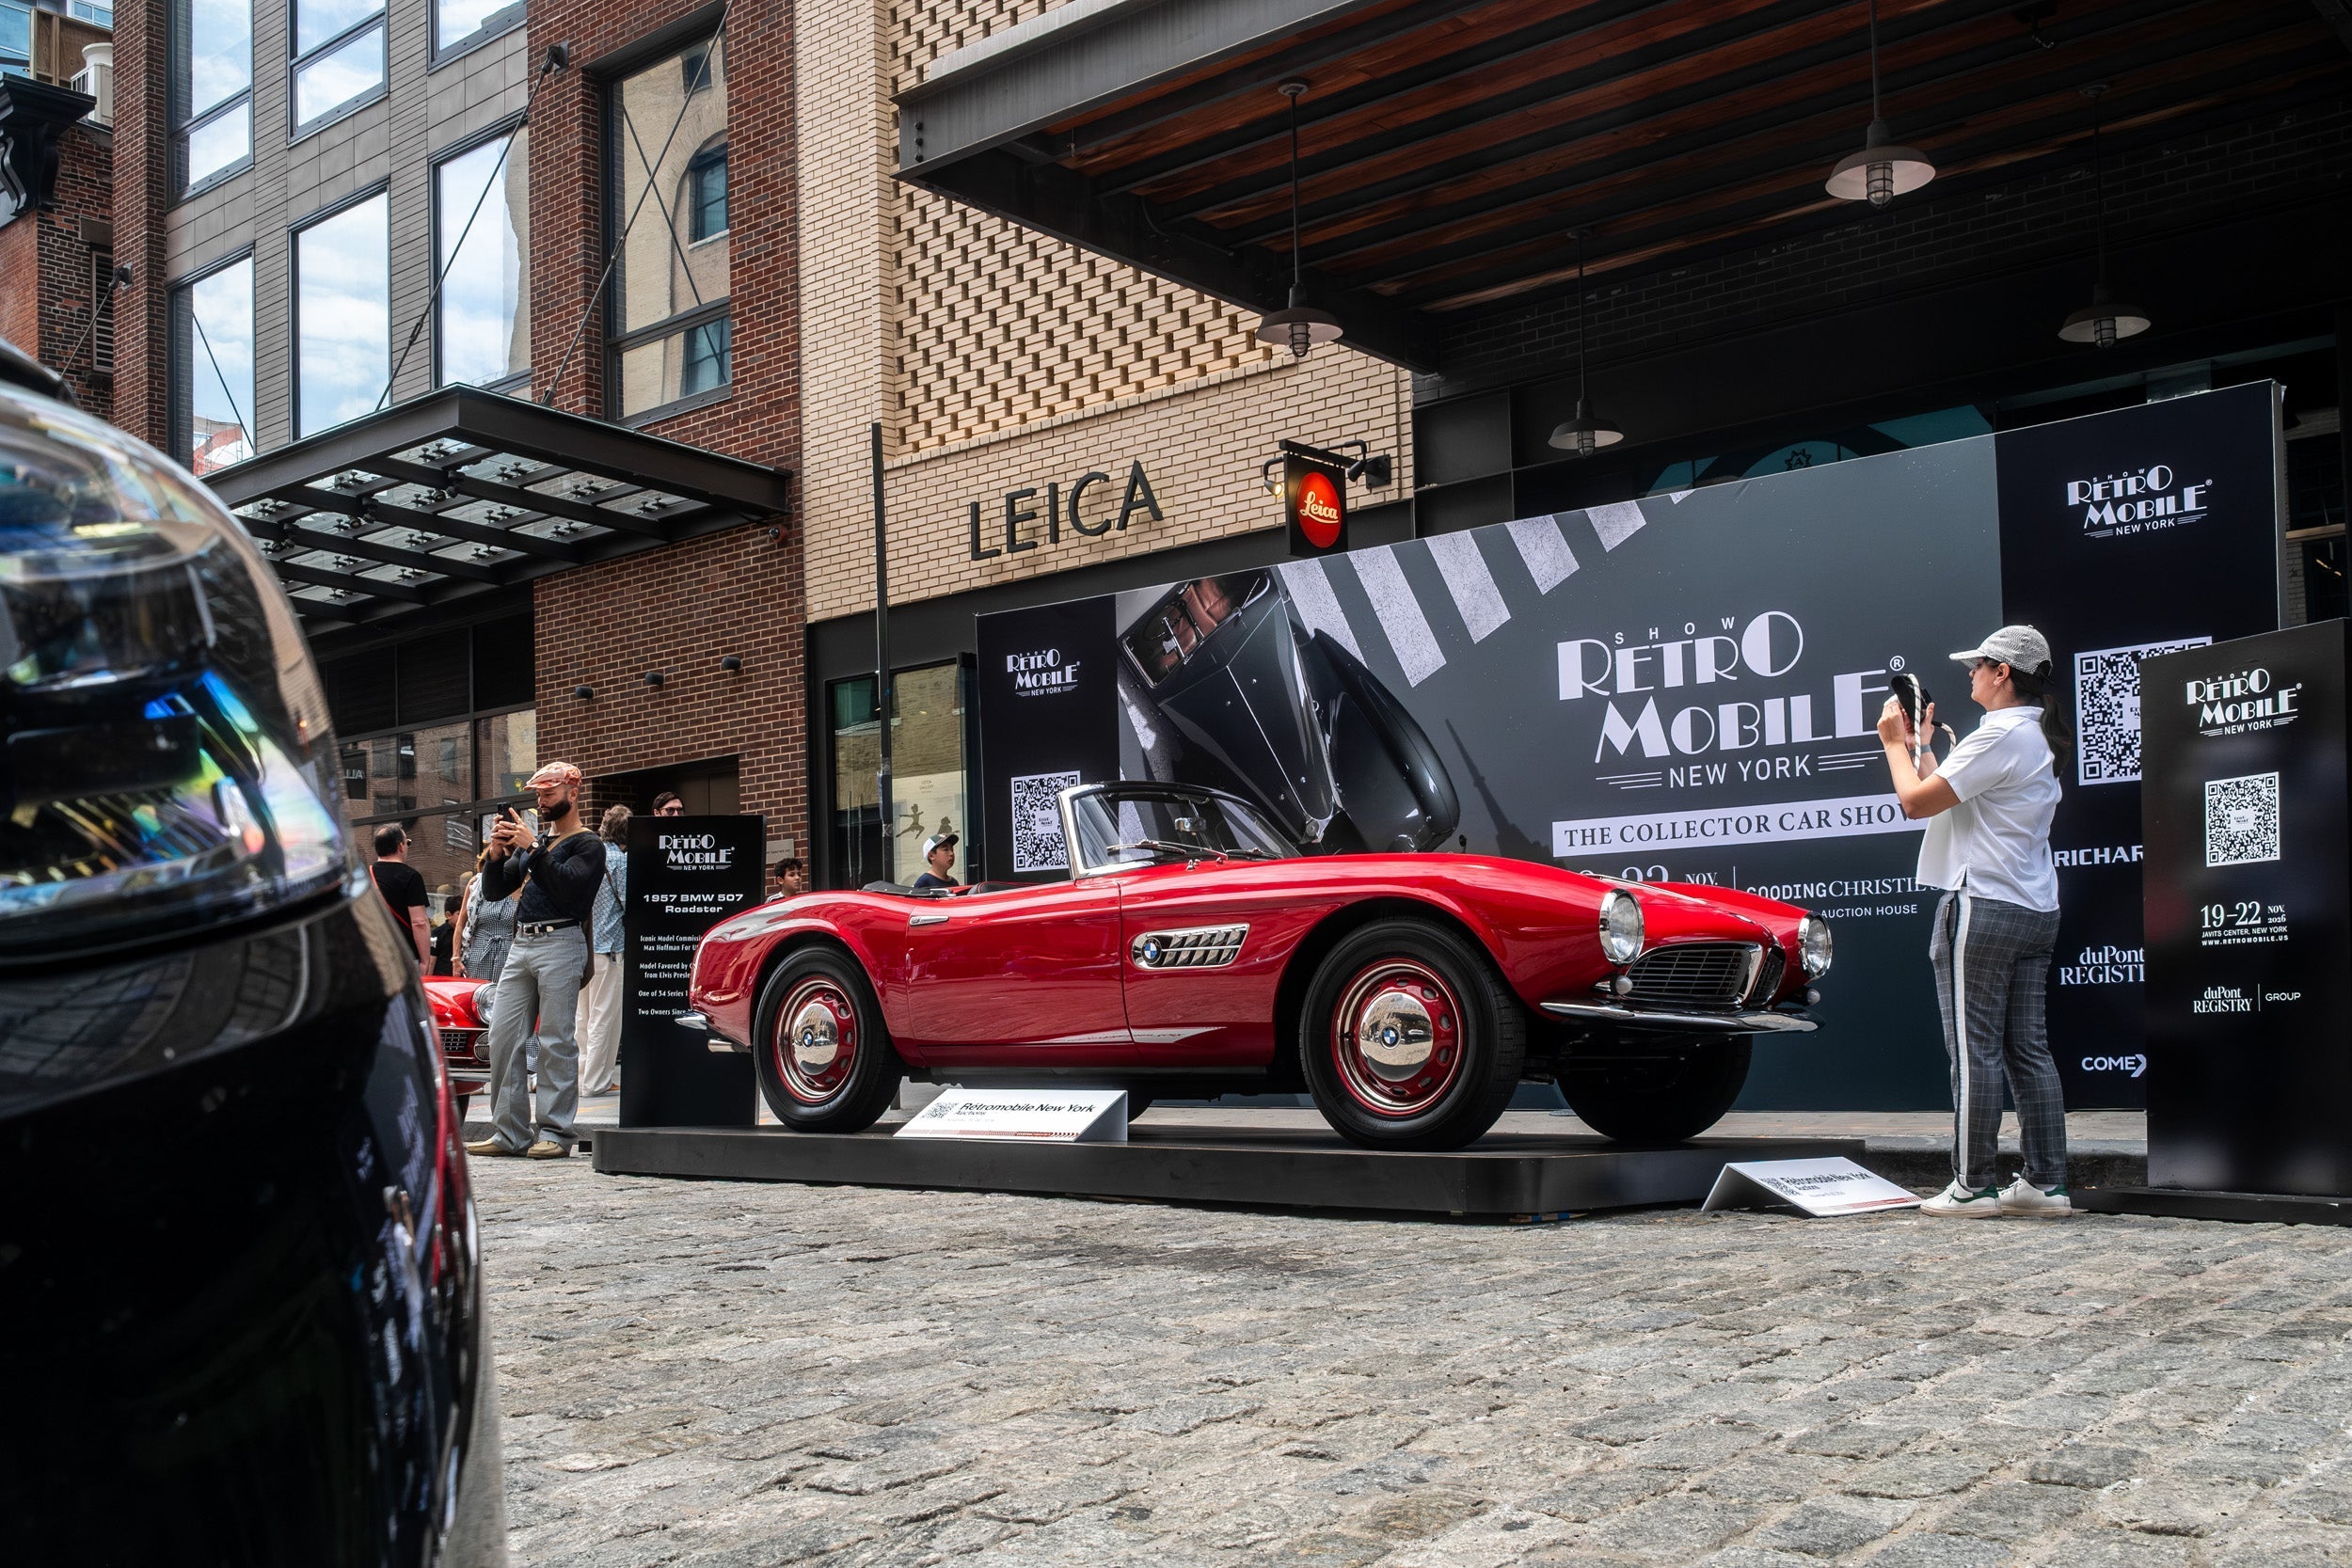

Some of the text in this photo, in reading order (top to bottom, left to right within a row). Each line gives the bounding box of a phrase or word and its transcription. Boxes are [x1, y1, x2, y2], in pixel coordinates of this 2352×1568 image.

[2092, 468, 2145, 483] SHOW
[2068, 465, 2172, 506] RETRO
[970, 459, 1164, 561] LEICA
[1299, 491, 1339, 524] Leica
[2116, 518, 2175, 535] NEW YORK
[1614, 616, 1735, 645] SHOW
[1007, 649, 1060, 673] RETRO
[1557, 611, 1804, 701] RETRO
[2186, 668, 2270, 705] RETRO
[2224, 719, 2272, 735] NEW YORK
[1669, 754, 1811, 788] NEW YORK
[1564, 827, 1613, 847] THE
[1619, 814, 1772, 844] COLLECTOR
[1778, 809, 1832, 832] CAR
[660, 834, 715, 849] RETRO
[1685, 872, 1718, 885] NOV.
[644, 894, 744, 902] 1957 BMW 507
[665, 905, 723, 913] Roadster
[1821, 904, 1917, 918] AUCTION HOUSE
[2267, 904, 2285, 913] NOV.
[2267, 914, 2286, 923] 2026
[2251, 927, 2267, 935] NEW
[2201, 935, 2289, 945] WWW.RETROMOBILE.US
[2079, 945, 2145, 965] duPont
[681, 962, 688, 971] by
[2203, 986, 2241, 999] duPont
[2193, 992, 2301, 1013] REGISTRY GROUP
[1035, 1103, 1065, 1112] New
[1067, 1103, 1096, 1113] York
